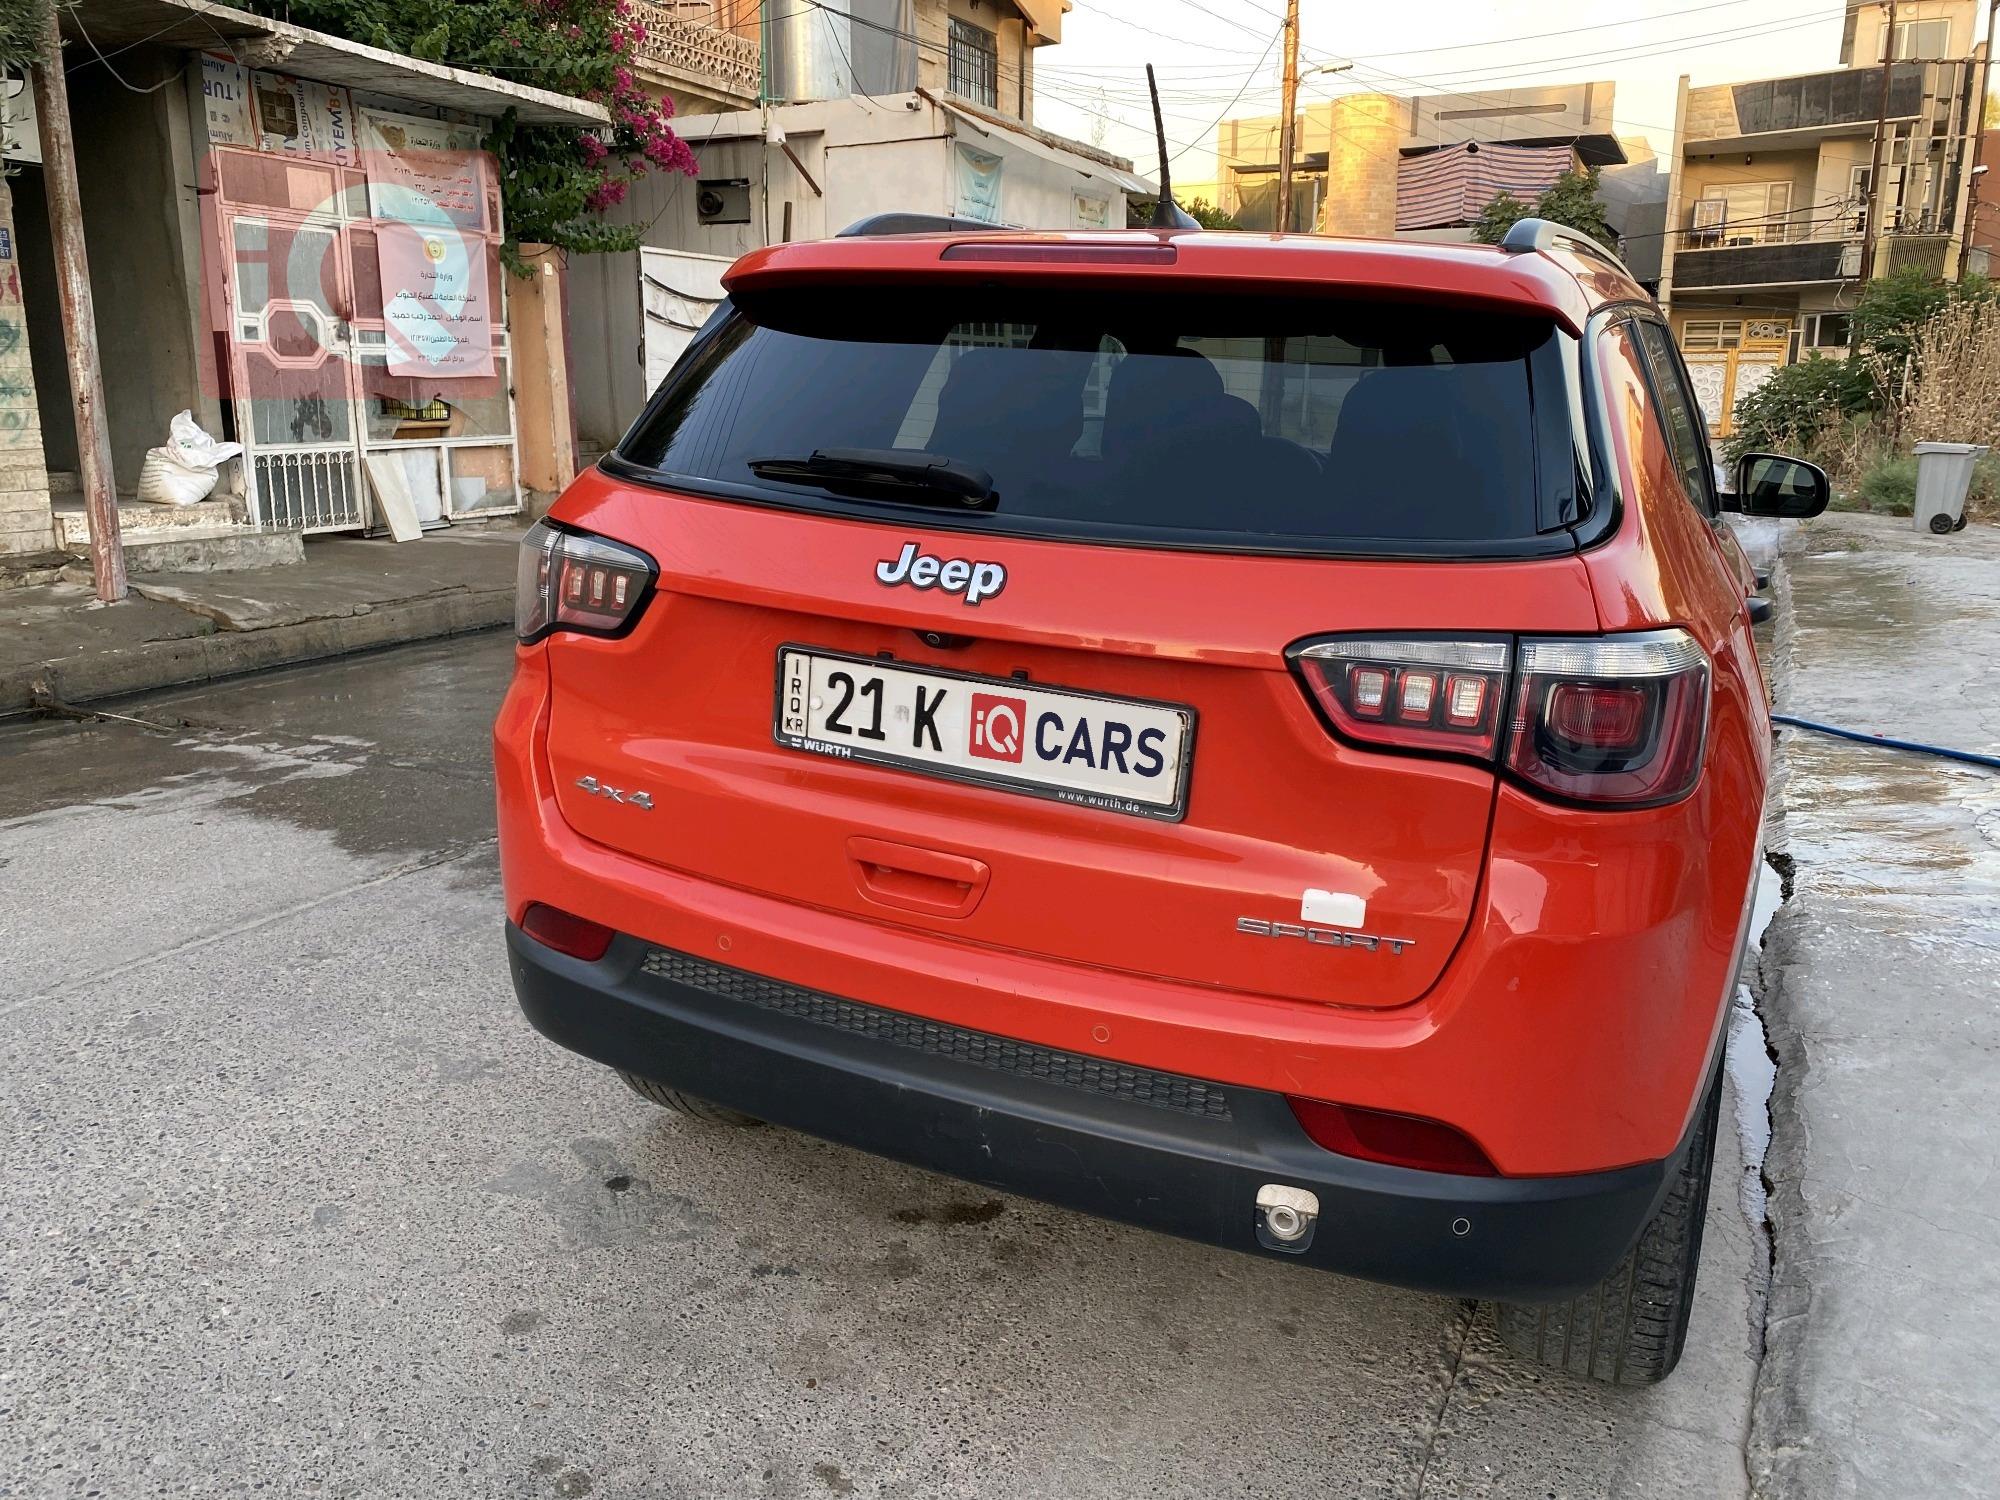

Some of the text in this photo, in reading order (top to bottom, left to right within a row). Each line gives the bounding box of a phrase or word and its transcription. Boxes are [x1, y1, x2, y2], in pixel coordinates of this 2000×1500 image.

[875, 541, 1008, 606] Jeep
[825, 671, 948, 752] 21 K
[576, 775, 656, 811] 4x4
[1236, 917, 1416, 955] SPORT
